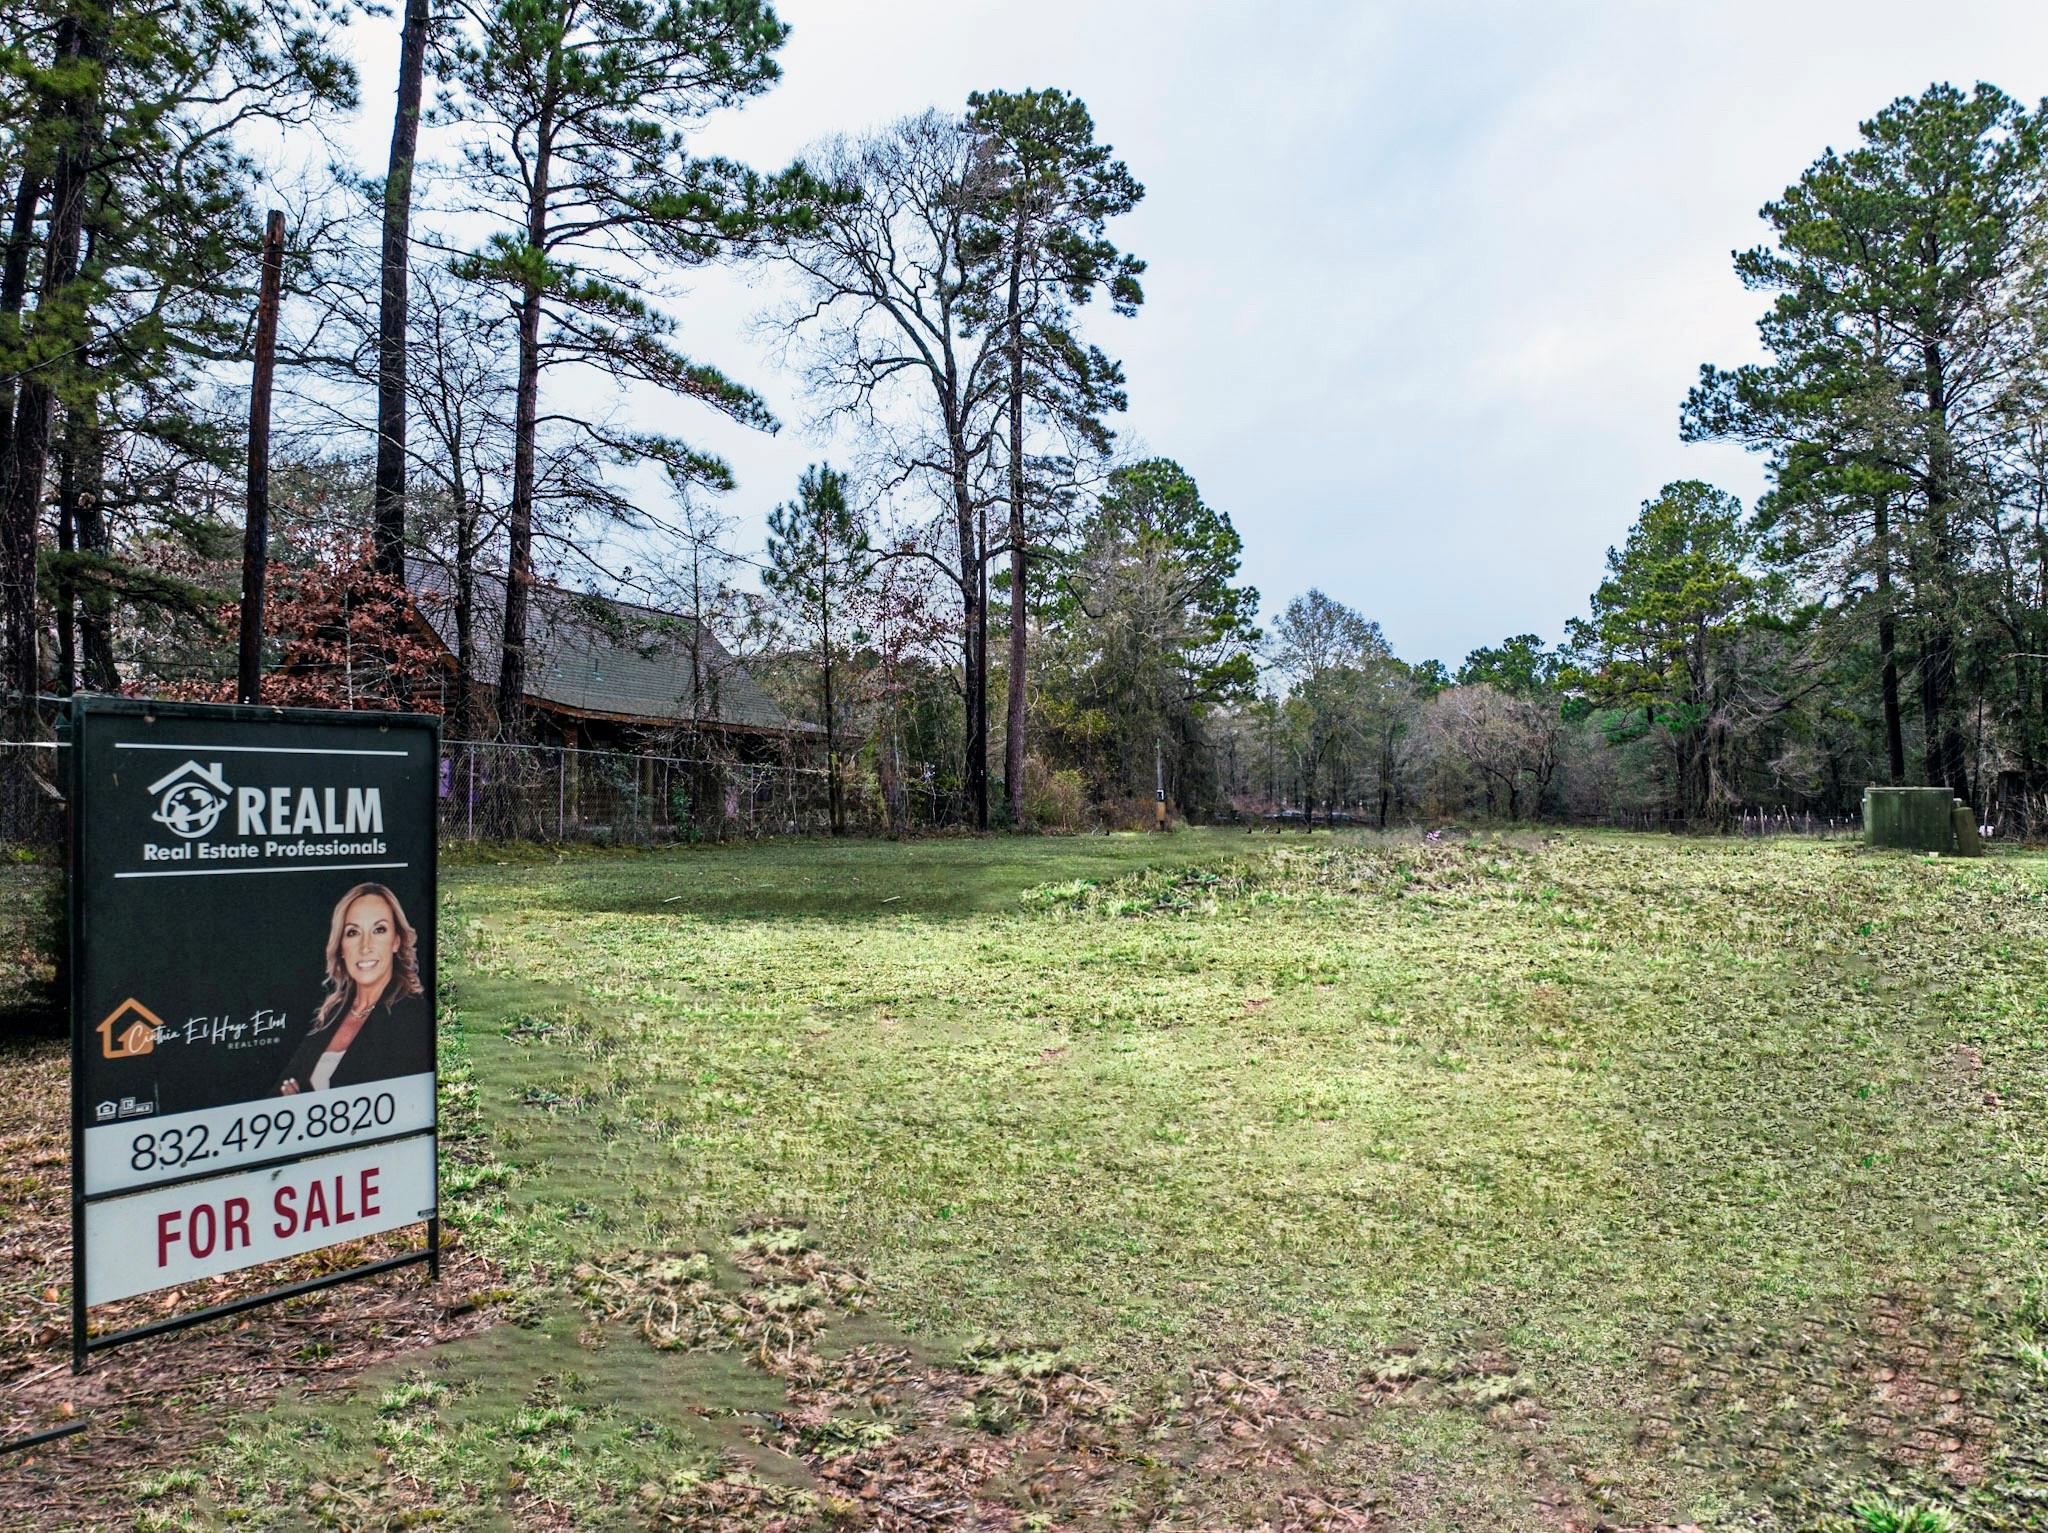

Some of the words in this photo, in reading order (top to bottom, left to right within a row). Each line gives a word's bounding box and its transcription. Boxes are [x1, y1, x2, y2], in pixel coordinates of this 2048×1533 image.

[237, 787, 384, 836] REALM
[143, 842, 191, 861] Real
[197, 842, 259, 859] Estate
[265, 838, 387, 857] Professionals
[182, 1017, 209, 1045] El
[131, 1092, 396, 1171] 832.499.8820
[157, 1196, 251, 1268] FOR
[273, 1167, 381, 1239] SALE
